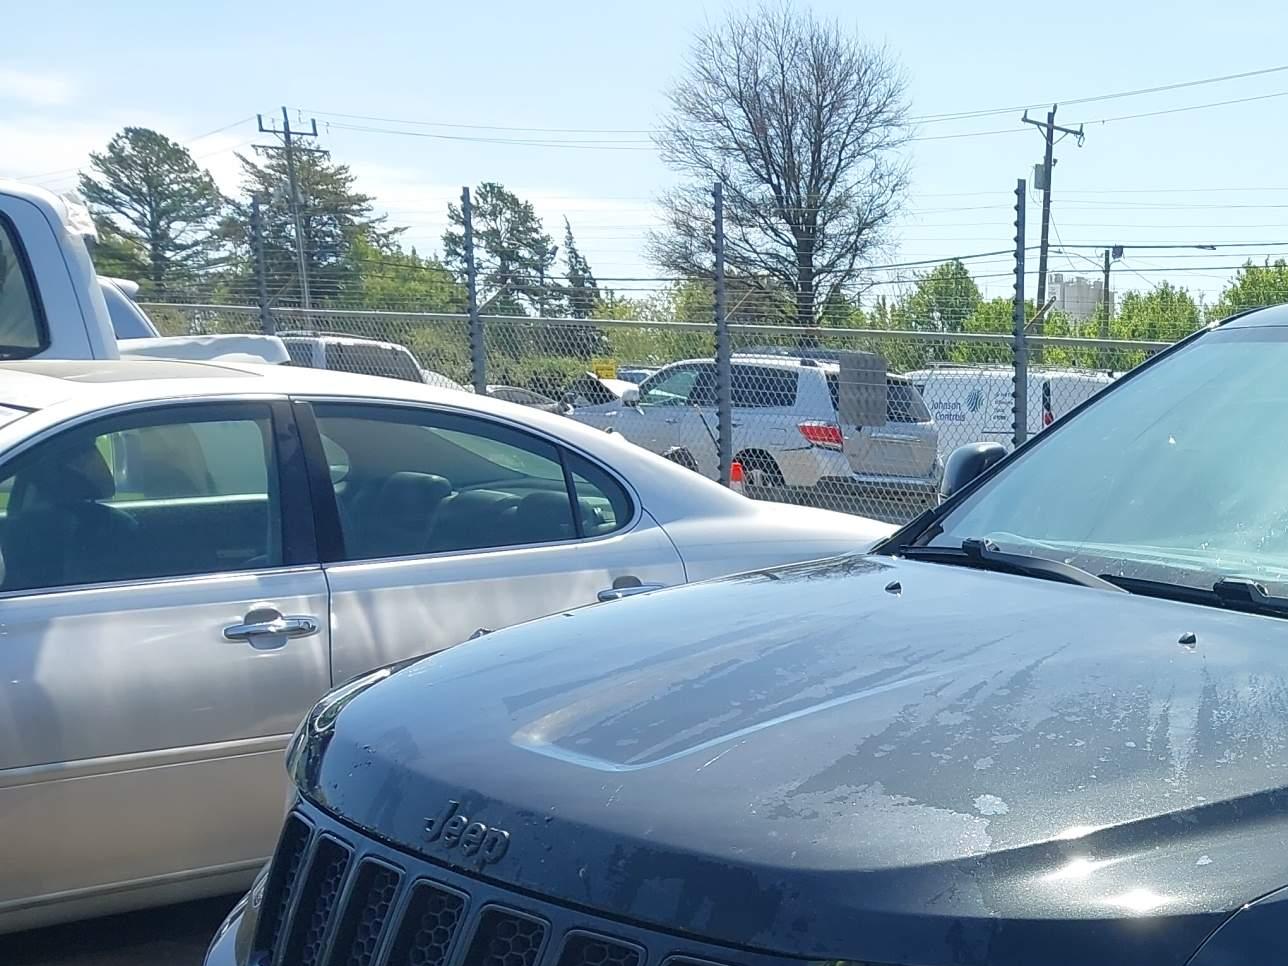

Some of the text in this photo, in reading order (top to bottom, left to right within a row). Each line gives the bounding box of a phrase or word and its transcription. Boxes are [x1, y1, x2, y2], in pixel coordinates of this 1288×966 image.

[931, 400, 961, 410] Johnson
[935, 411, 966, 421] Controls
[423, 799, 511, 871] Jeep
